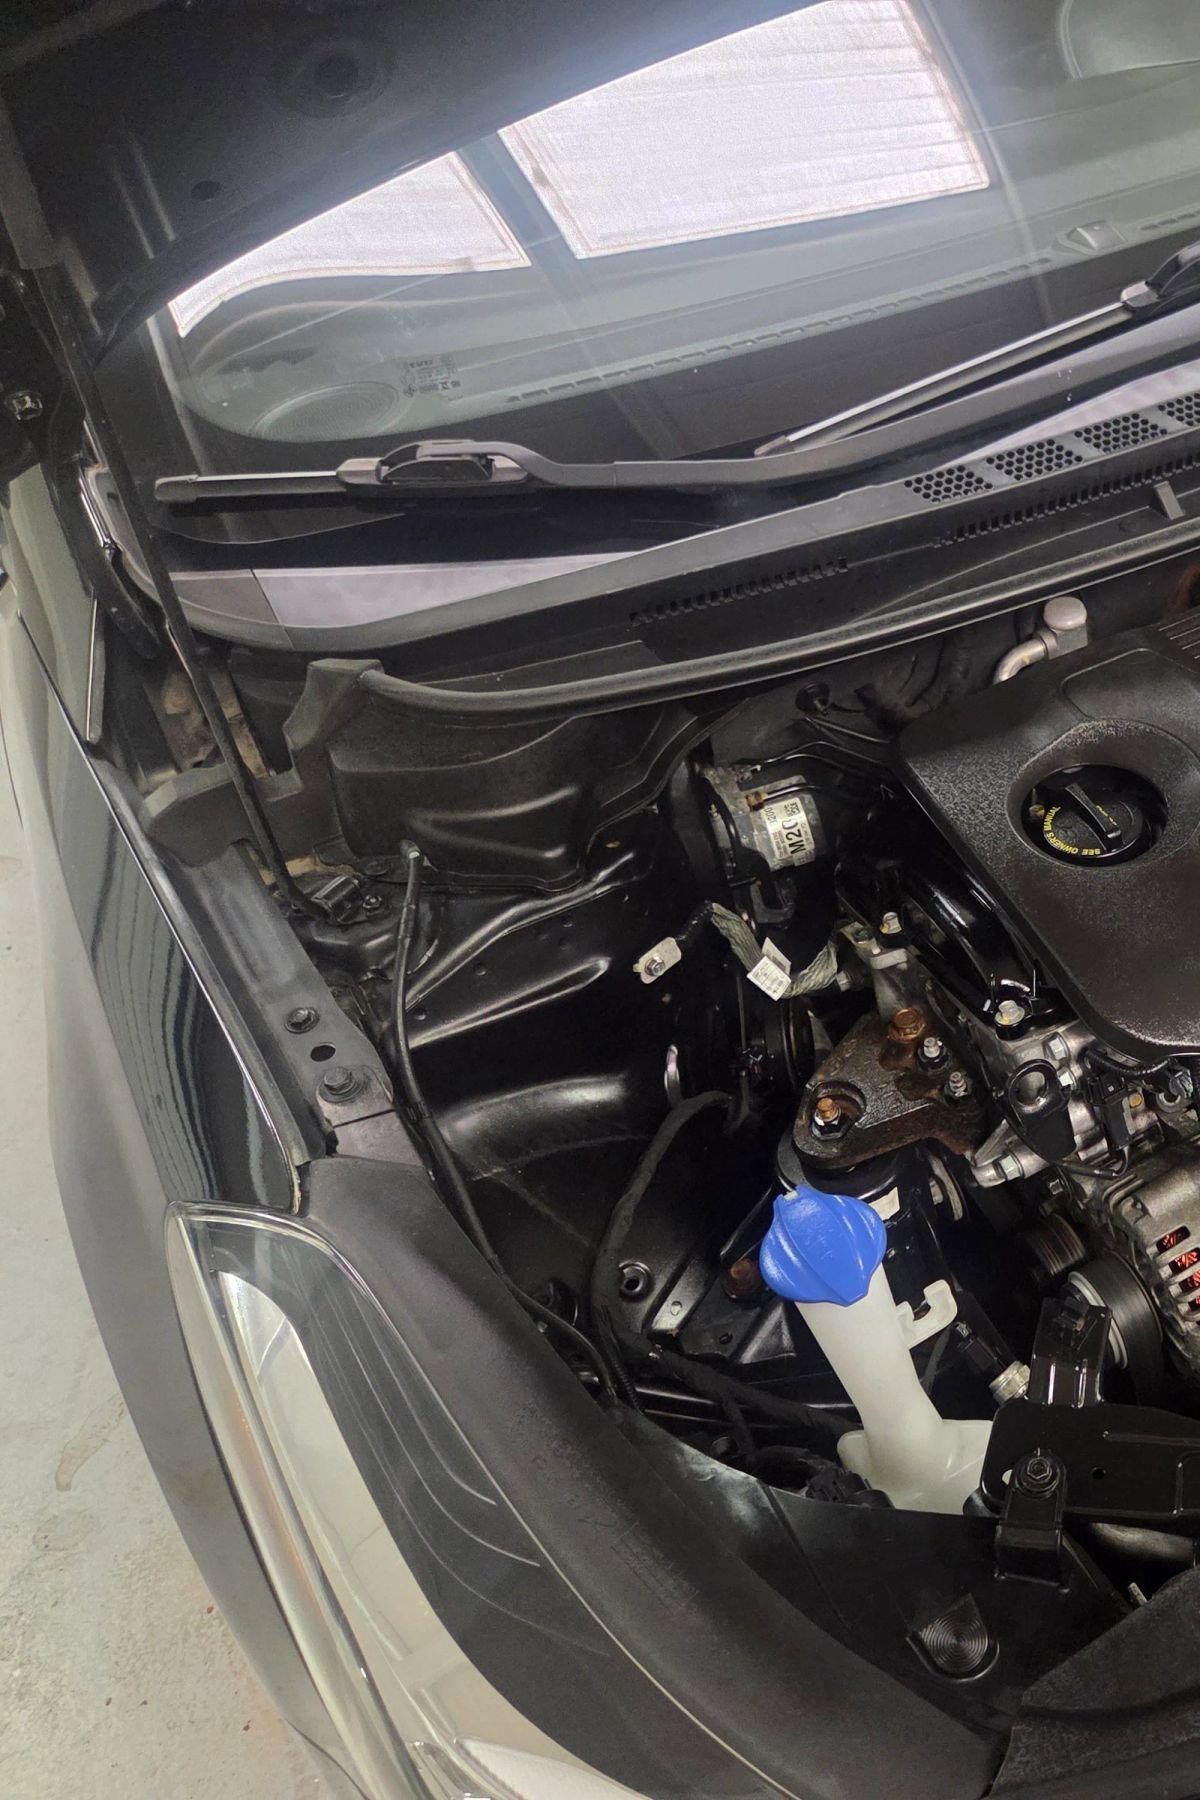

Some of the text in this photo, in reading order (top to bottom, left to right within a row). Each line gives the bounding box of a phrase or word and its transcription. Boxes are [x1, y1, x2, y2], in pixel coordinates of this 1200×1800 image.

[1042, 805, 1101, 856] SEE OWNER'S MANUAL
